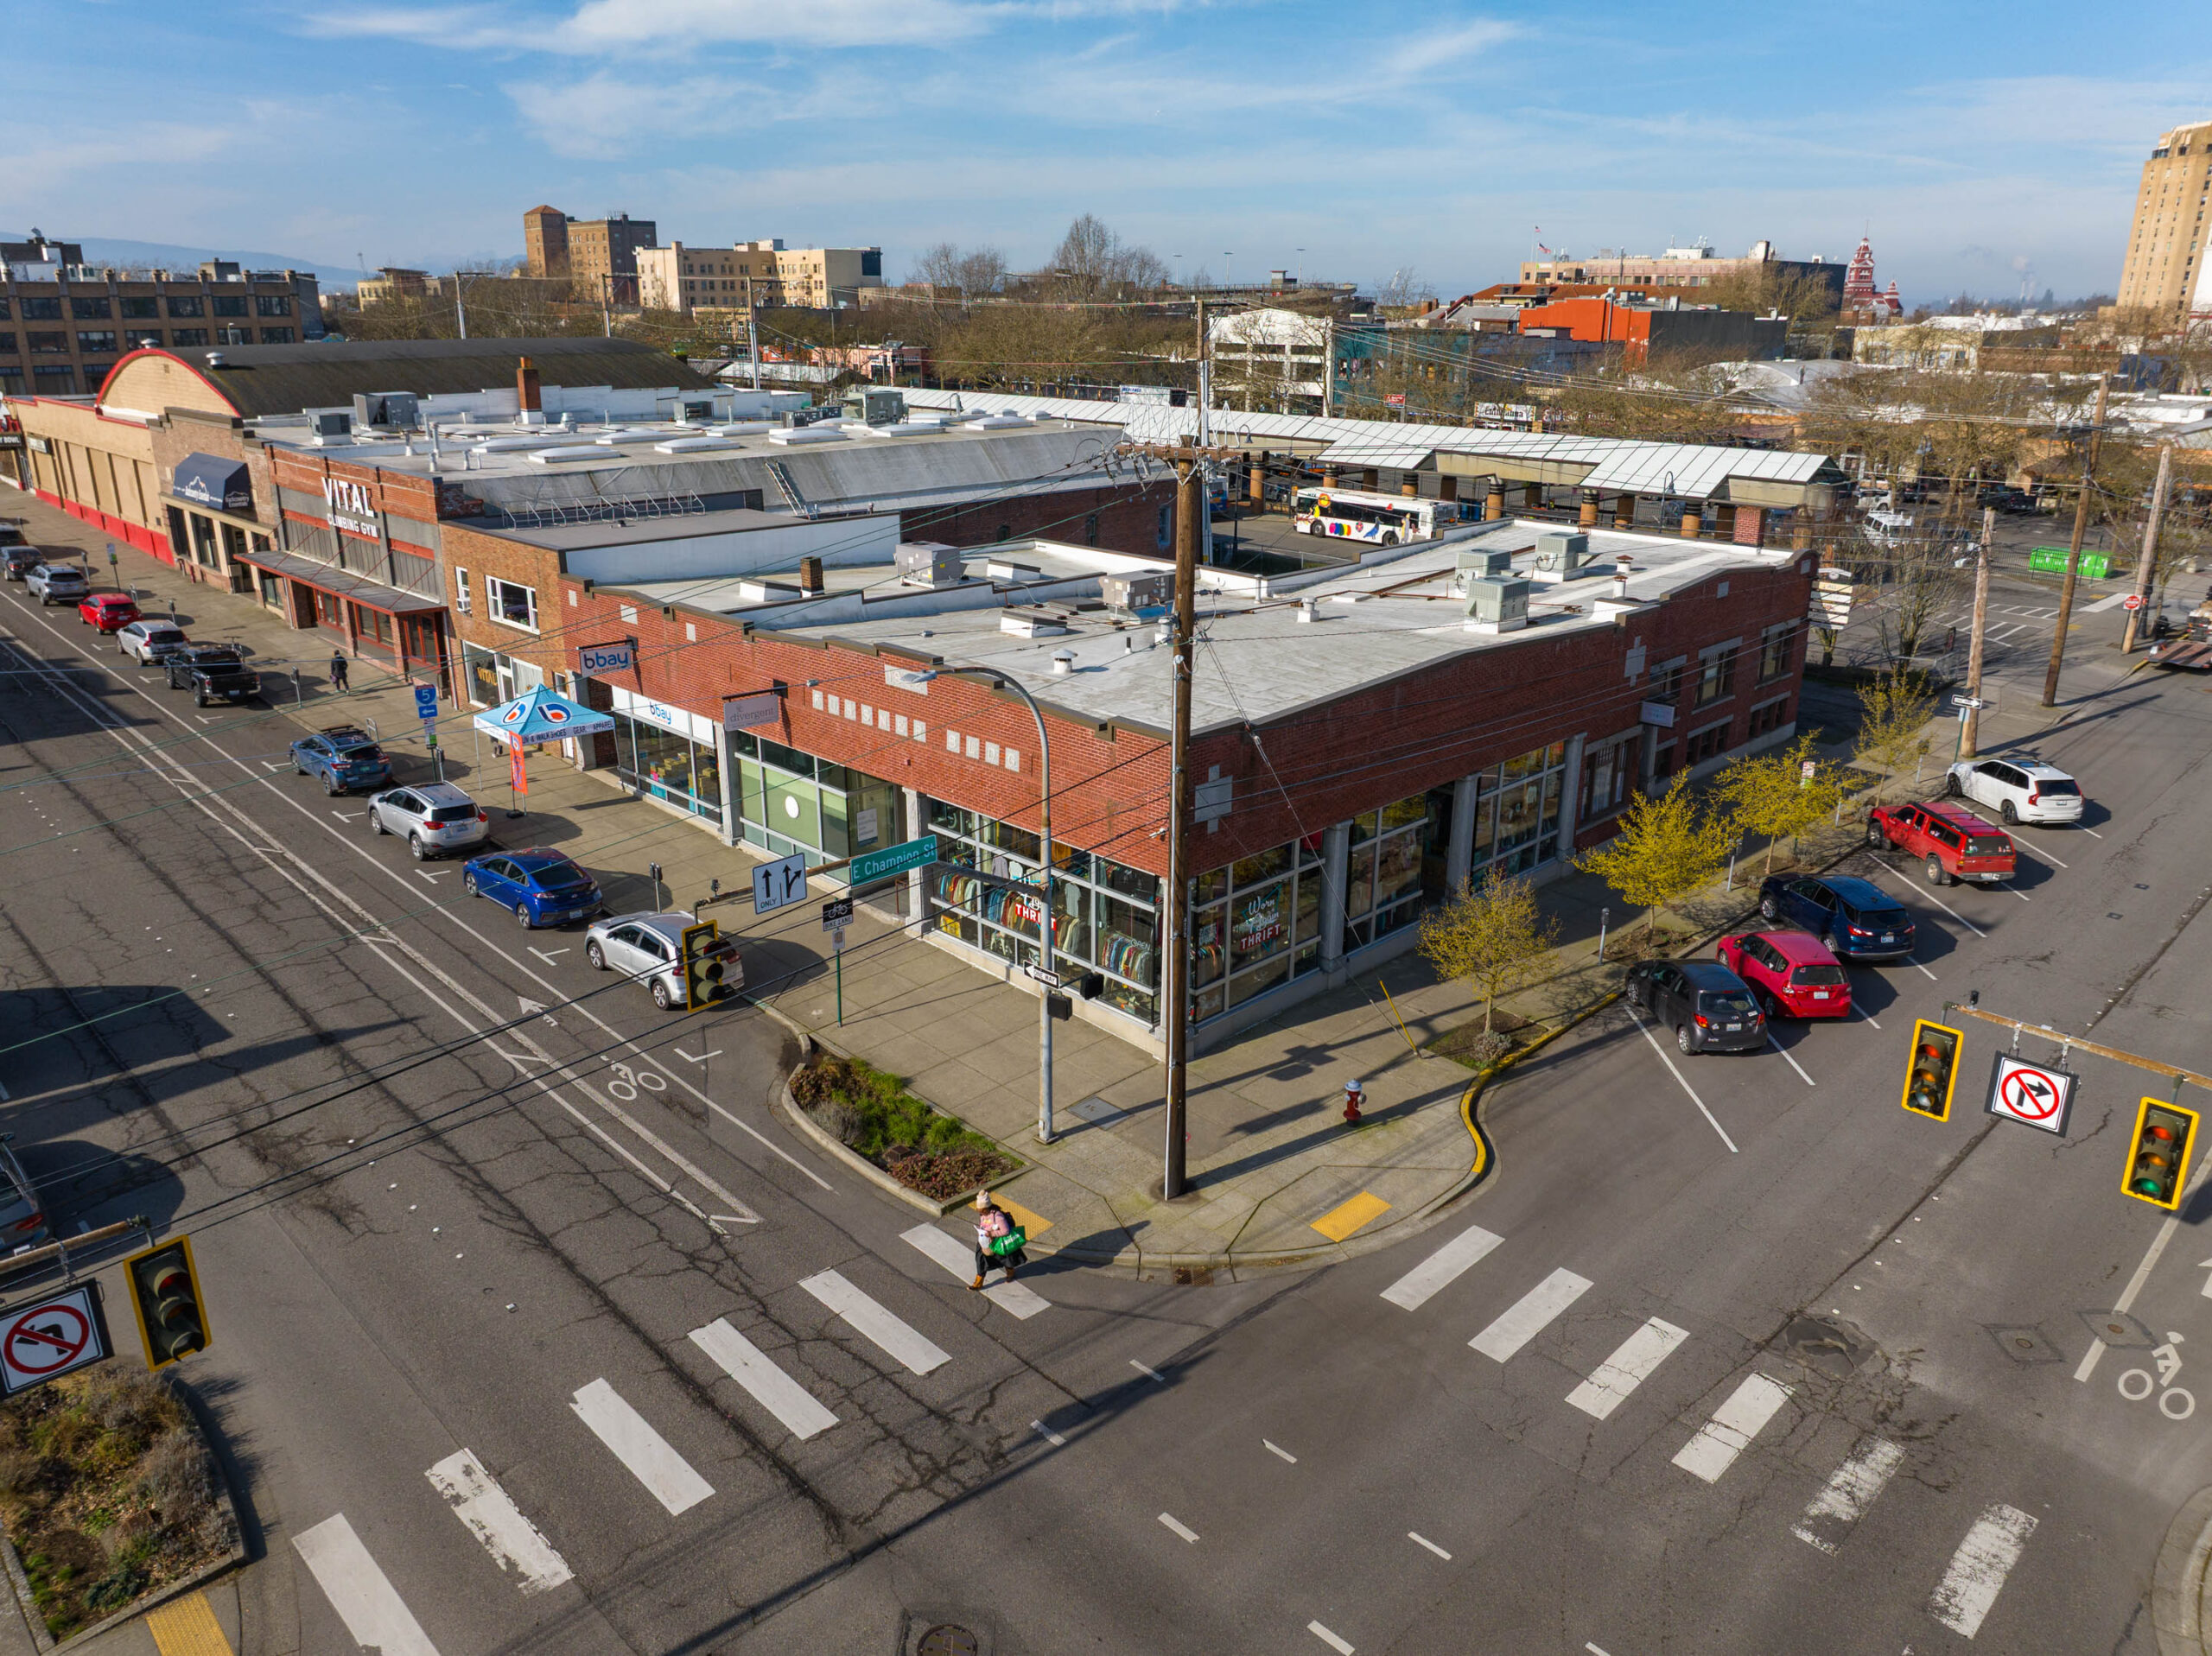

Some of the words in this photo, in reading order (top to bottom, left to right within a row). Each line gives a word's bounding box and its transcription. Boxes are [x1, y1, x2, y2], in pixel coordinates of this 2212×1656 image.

[321, 477, 374, 517] VITAL
[327, 513, 359, 532] CLIMBING
[361, 522, 378, 538] GYM
[584, 651, 628, 669] bbay
[477, 667, 498, 687] VITAL
[422, 688, 430, 701] 5
[650, 701, 671, 725] bbay
[730, 707, 773, 723] divergent
[537, 733, 550, 741] WALK
[550, 728, 567, 739] SHOES
[853, 865, 860, 879] E
[864, 850, 919, 876] Champion
[924, 843, 935, 858] St
[760, 898, 777, 909] ONLY
[1249, 896, 1274, 916] Worn
[824, 918, 836, 930] BIKE
[837, 916, 852, 926] LANE
[1016, 904, 1057, 930] THRIT
[1241, 923, 1281, 949] THRIFT
[1033, 969, 1044, 980] ONE
[1045, 974, 1055, 983] WAY
